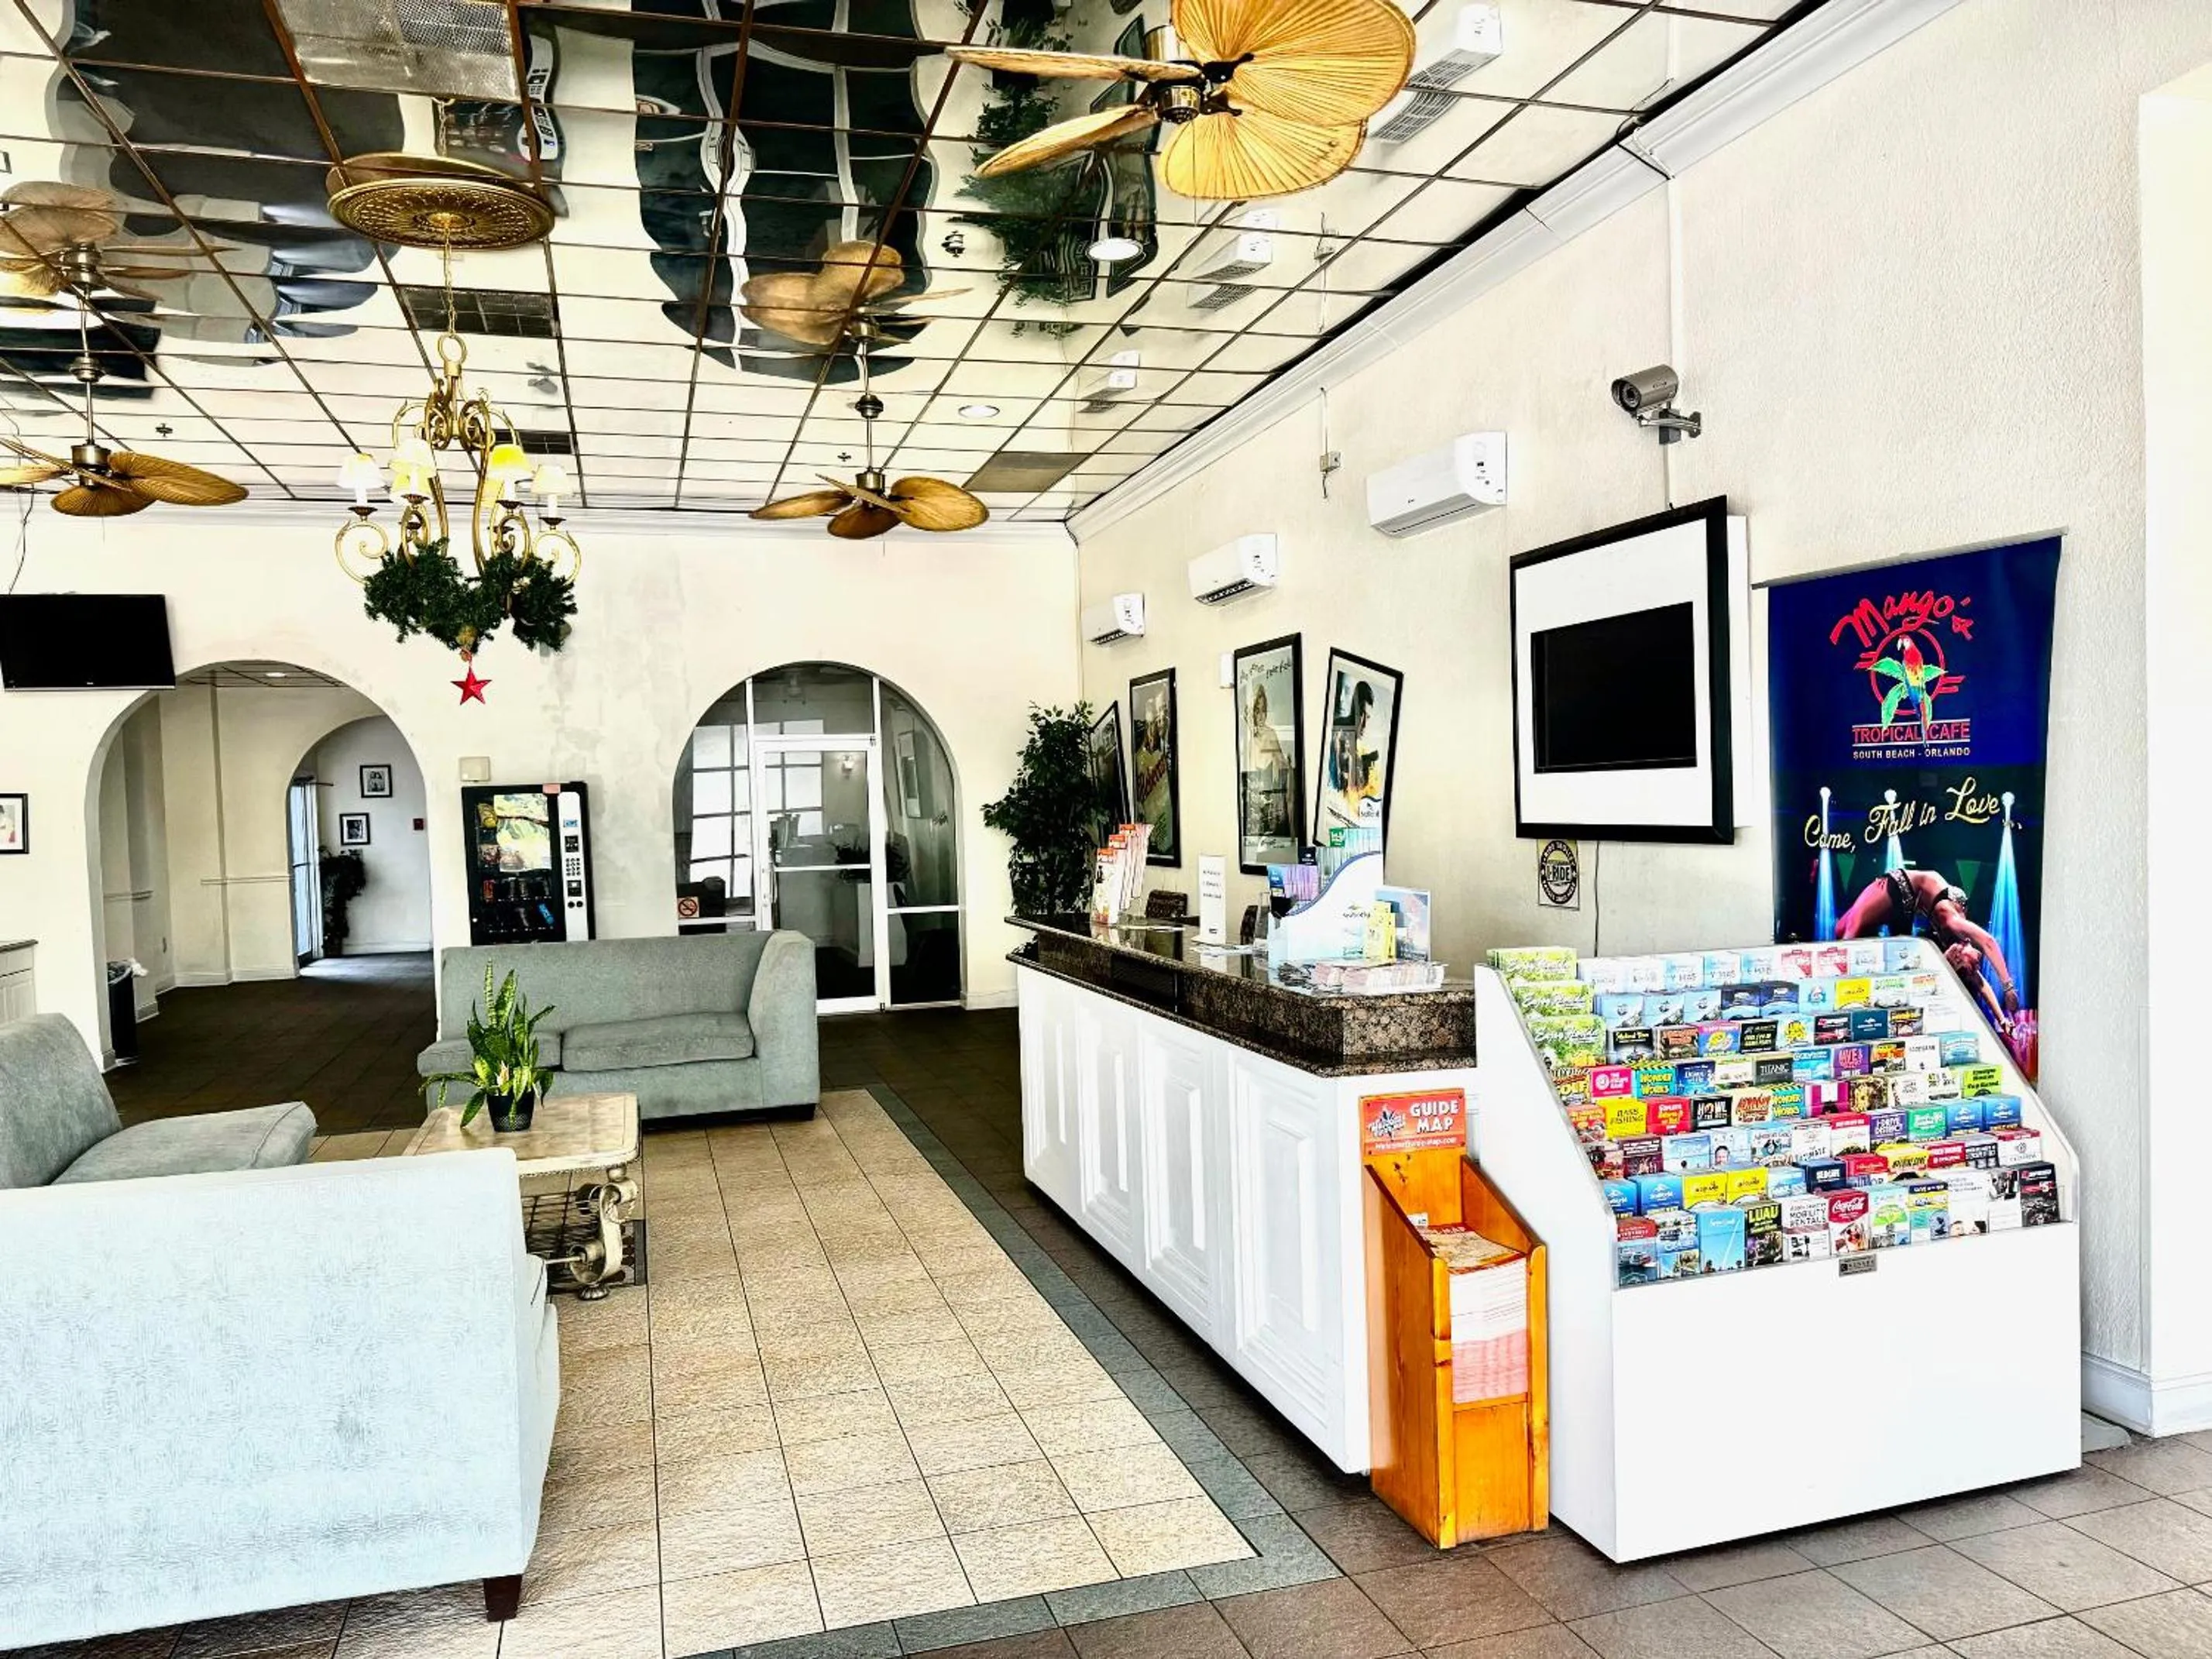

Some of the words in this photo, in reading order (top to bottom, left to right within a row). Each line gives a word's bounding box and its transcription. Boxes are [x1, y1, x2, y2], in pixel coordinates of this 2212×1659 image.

[1829, 591, 1973, 646] Mango's
[1852, 725, 1921, 743] TROPICAL
[1926, 722, 1970, 740] CAFE
[1853, 750, 1882, 759] SOUTH
[1886, 749, 1915, 758] BEACH
[1925, 747, 1970, 757] ORLANDO
[1865, 801, 1916, 843] Fall
[1919, 803, 1937, 826] in
[1760, 1063, 1789, 1076] TITANIC
[1410, 1100, 1459, 1117] GUIDE
[1417, 1117, 1454, 1133] MAP
[1609, 1115, 1644, 1125] FISHING
[1748, 1205, 1779, 1223] LUAU
[1789, 1207, 1826, 1219] MOBILITY
[1789, 1215, 1826, 1227] RENTALS
